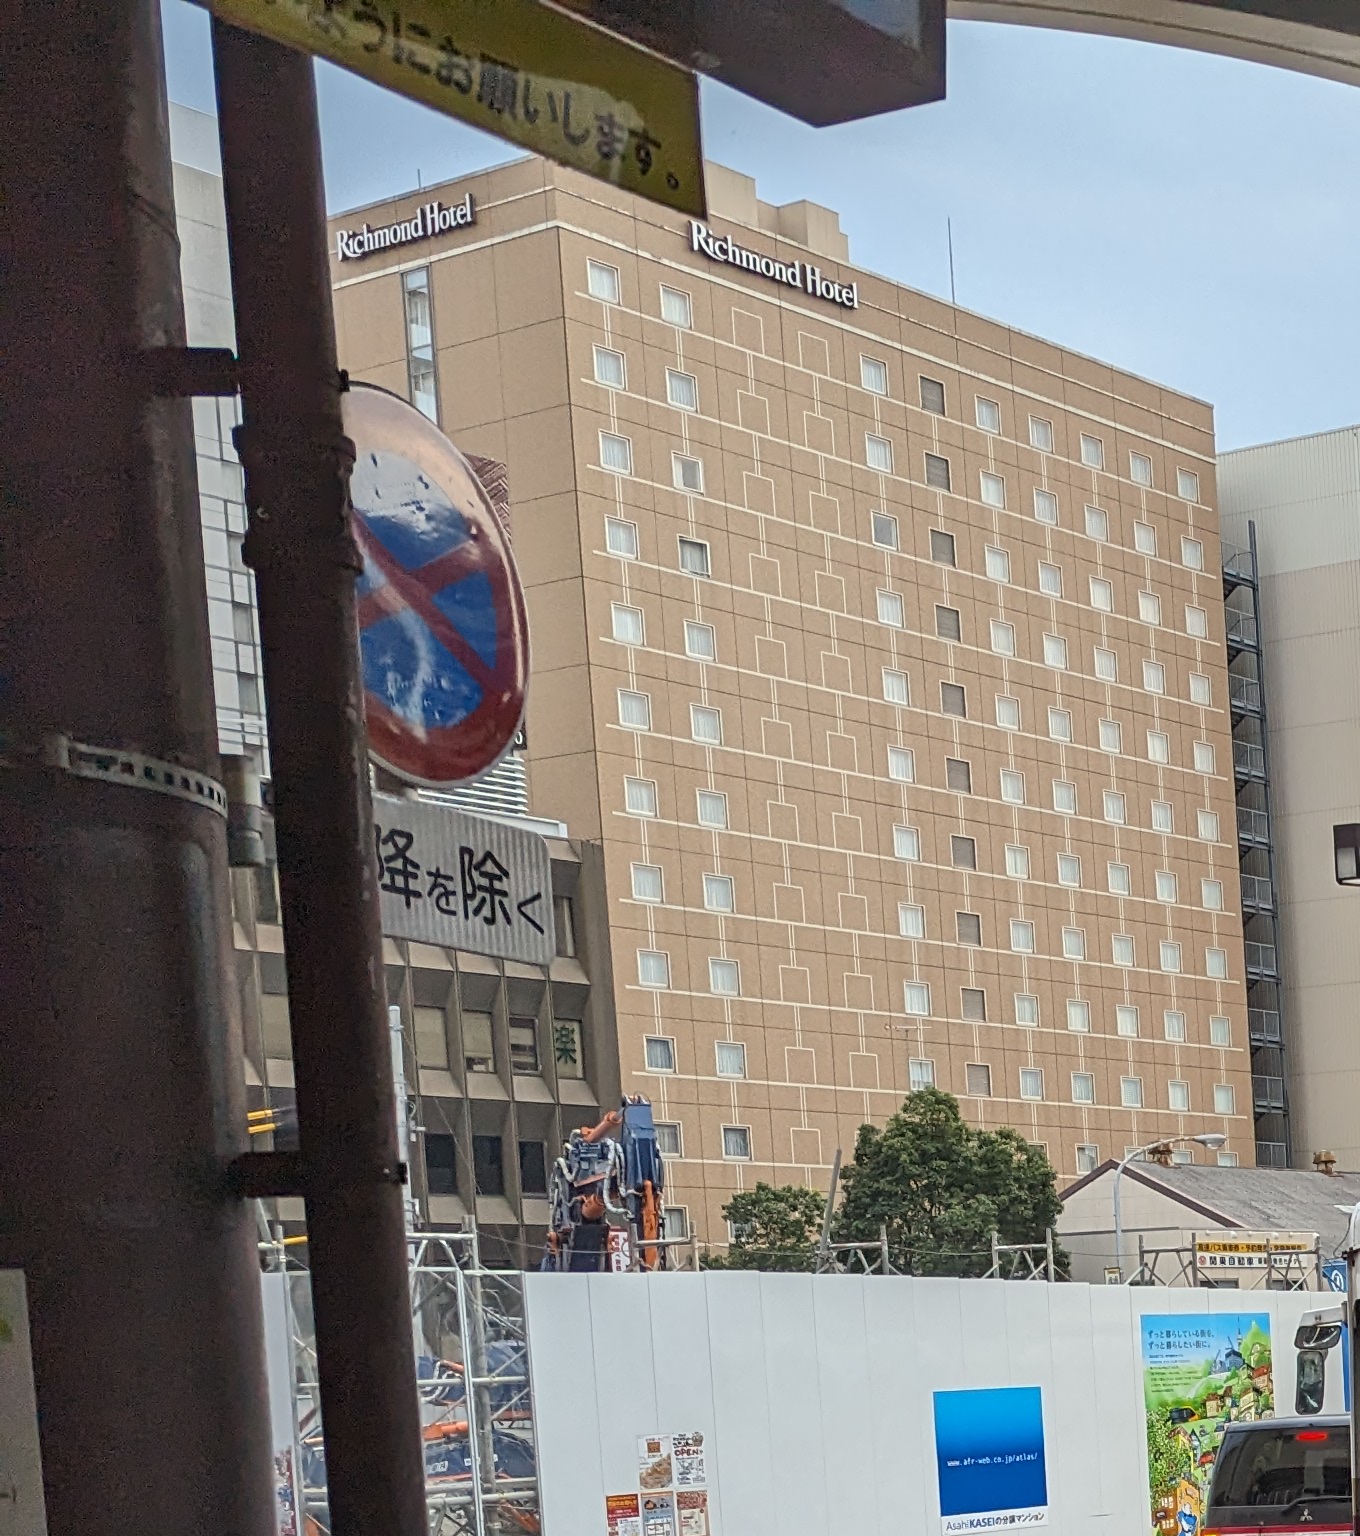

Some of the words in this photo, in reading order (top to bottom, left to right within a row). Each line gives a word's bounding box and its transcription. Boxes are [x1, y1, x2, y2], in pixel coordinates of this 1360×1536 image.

[335, 217, 425, 262] Richmond
[425, 193, 475, 236] Hotel
[688, 219, 802, 288] Richmond
[804, 263, 859, 309] Hotel
